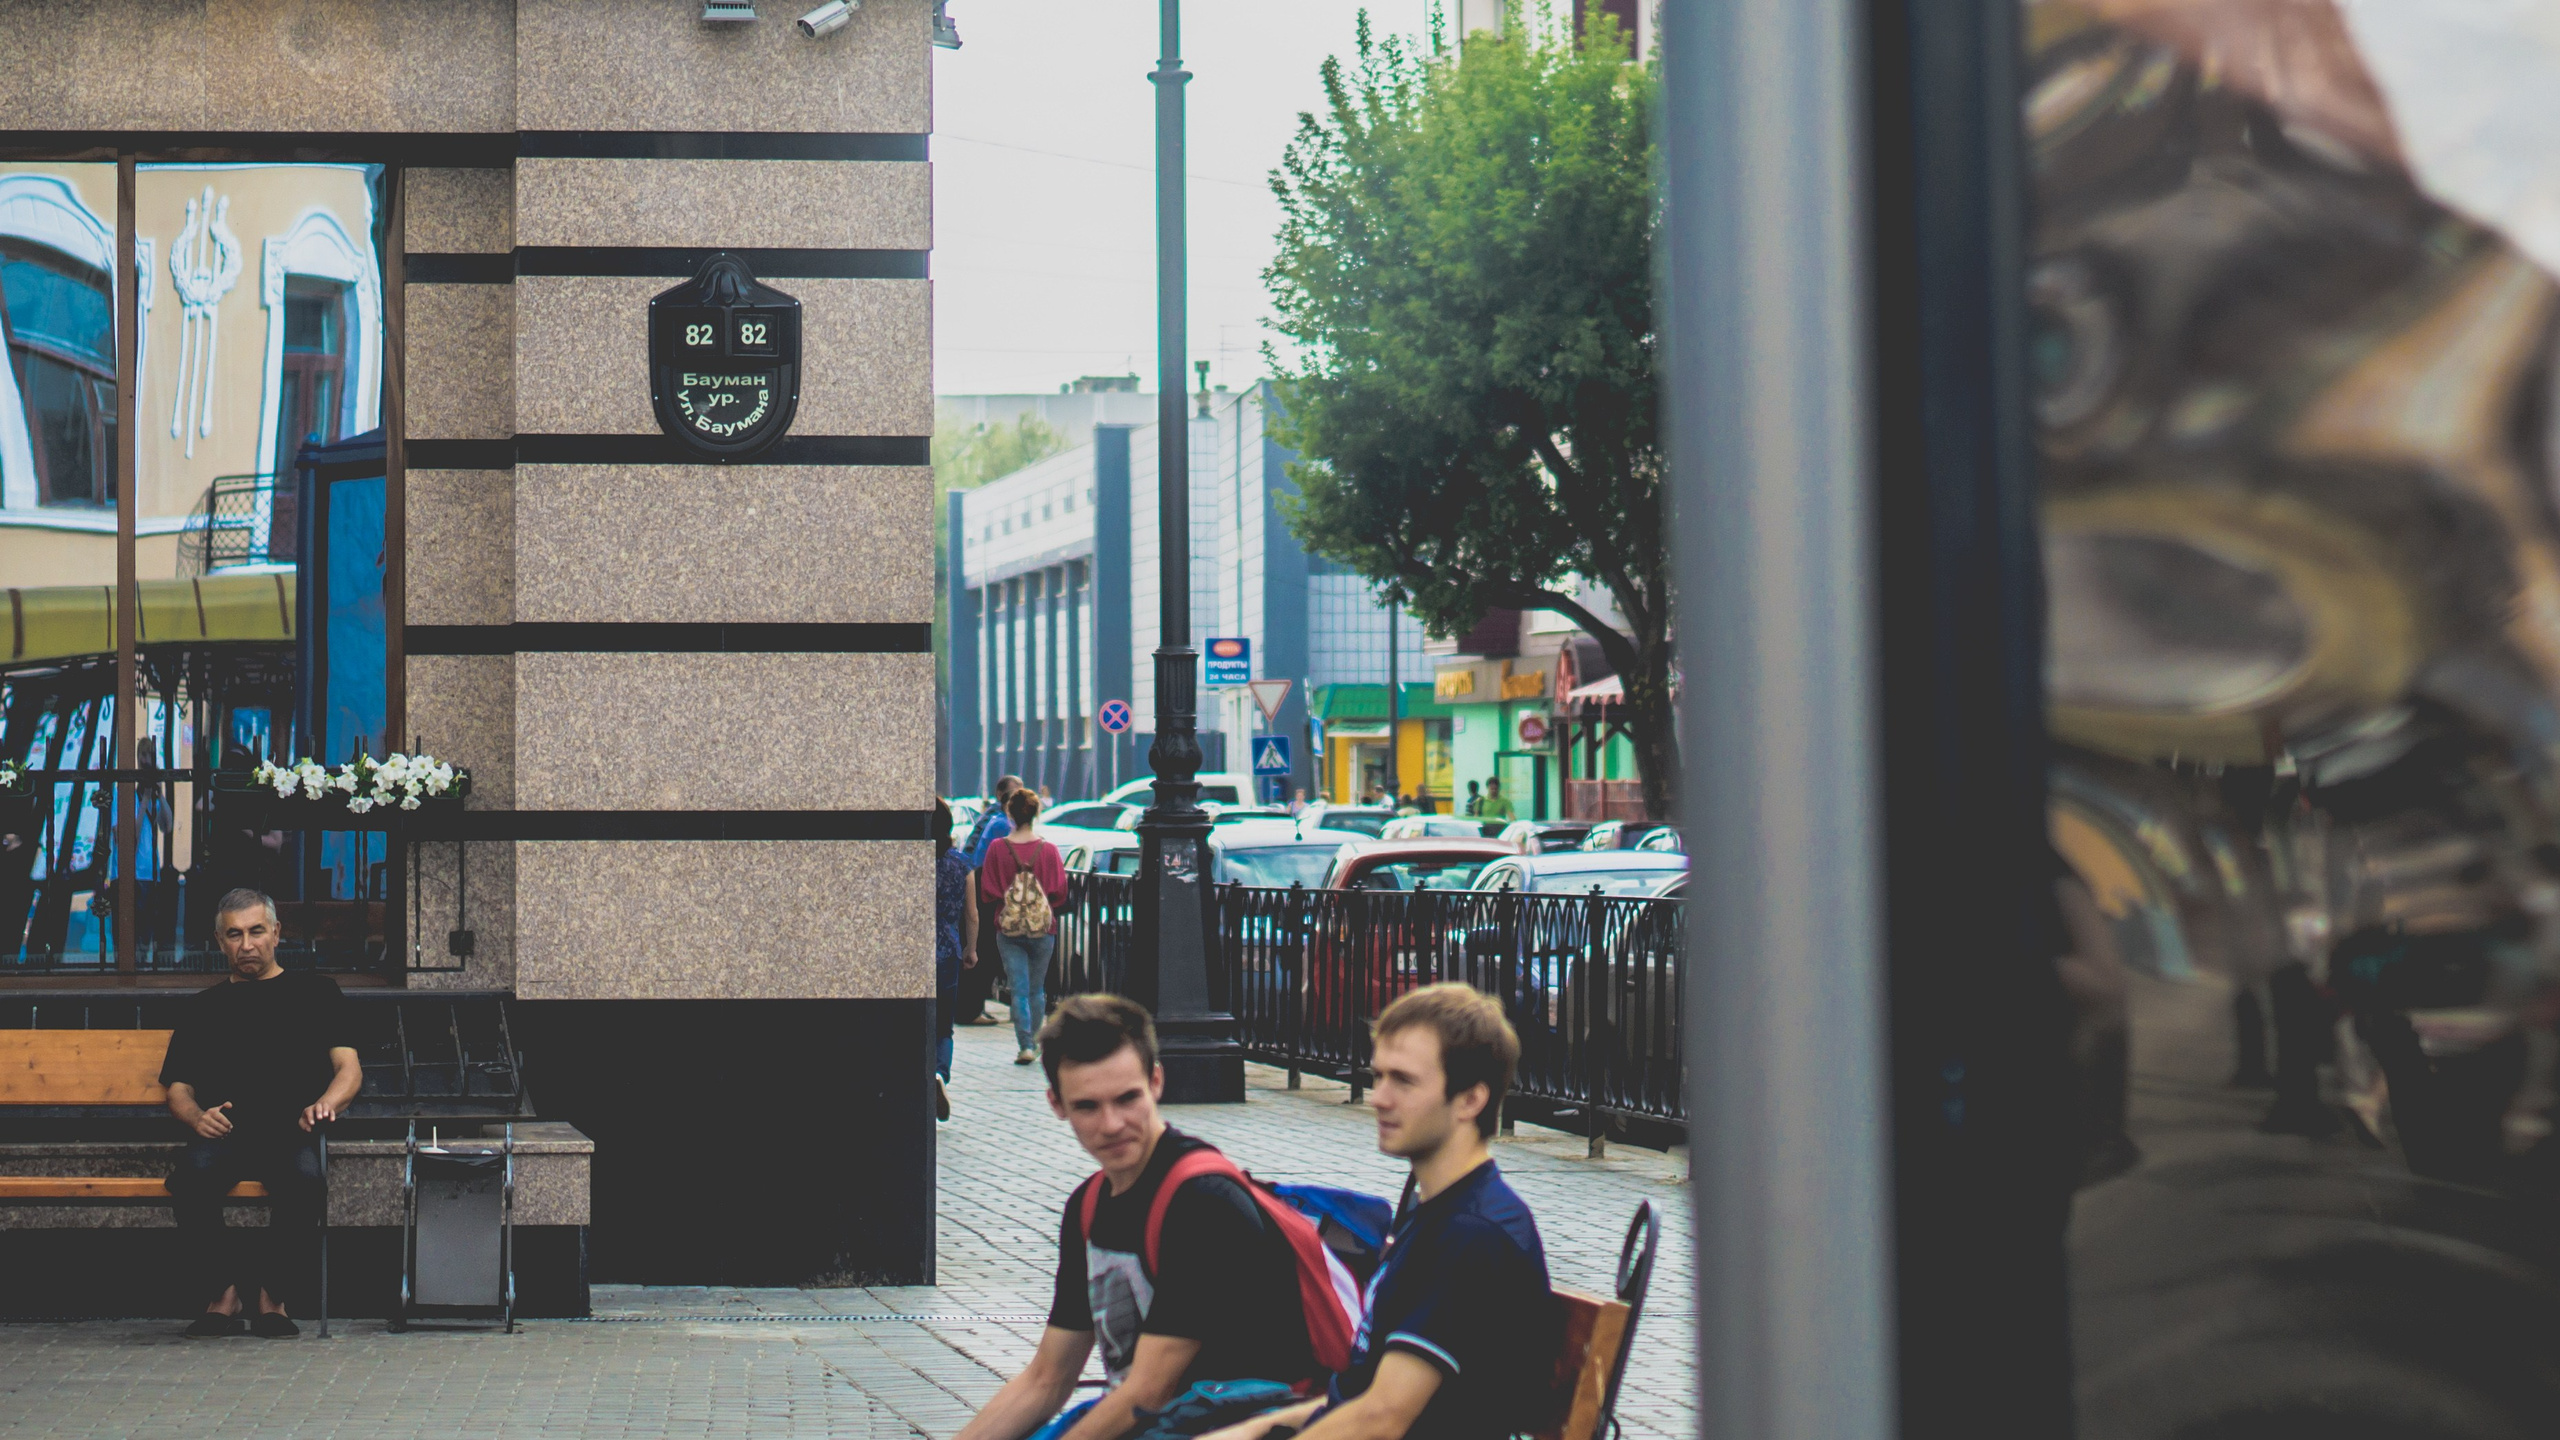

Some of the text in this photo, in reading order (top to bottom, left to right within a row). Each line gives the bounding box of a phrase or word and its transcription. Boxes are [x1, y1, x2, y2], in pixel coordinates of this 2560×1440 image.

[685, 324, 713, 346] 82
[741, 323, 767, 345] 82
[683, 373, 766, 389] Бауман
[708, 393, 740, 407] ур.
[677, 389, 769, 437] ул. Баумана
[1207, 661, 1247, 670] ПРОДУКТЫ
[1209, 673, 1247, 681] 24 ЧАСА
